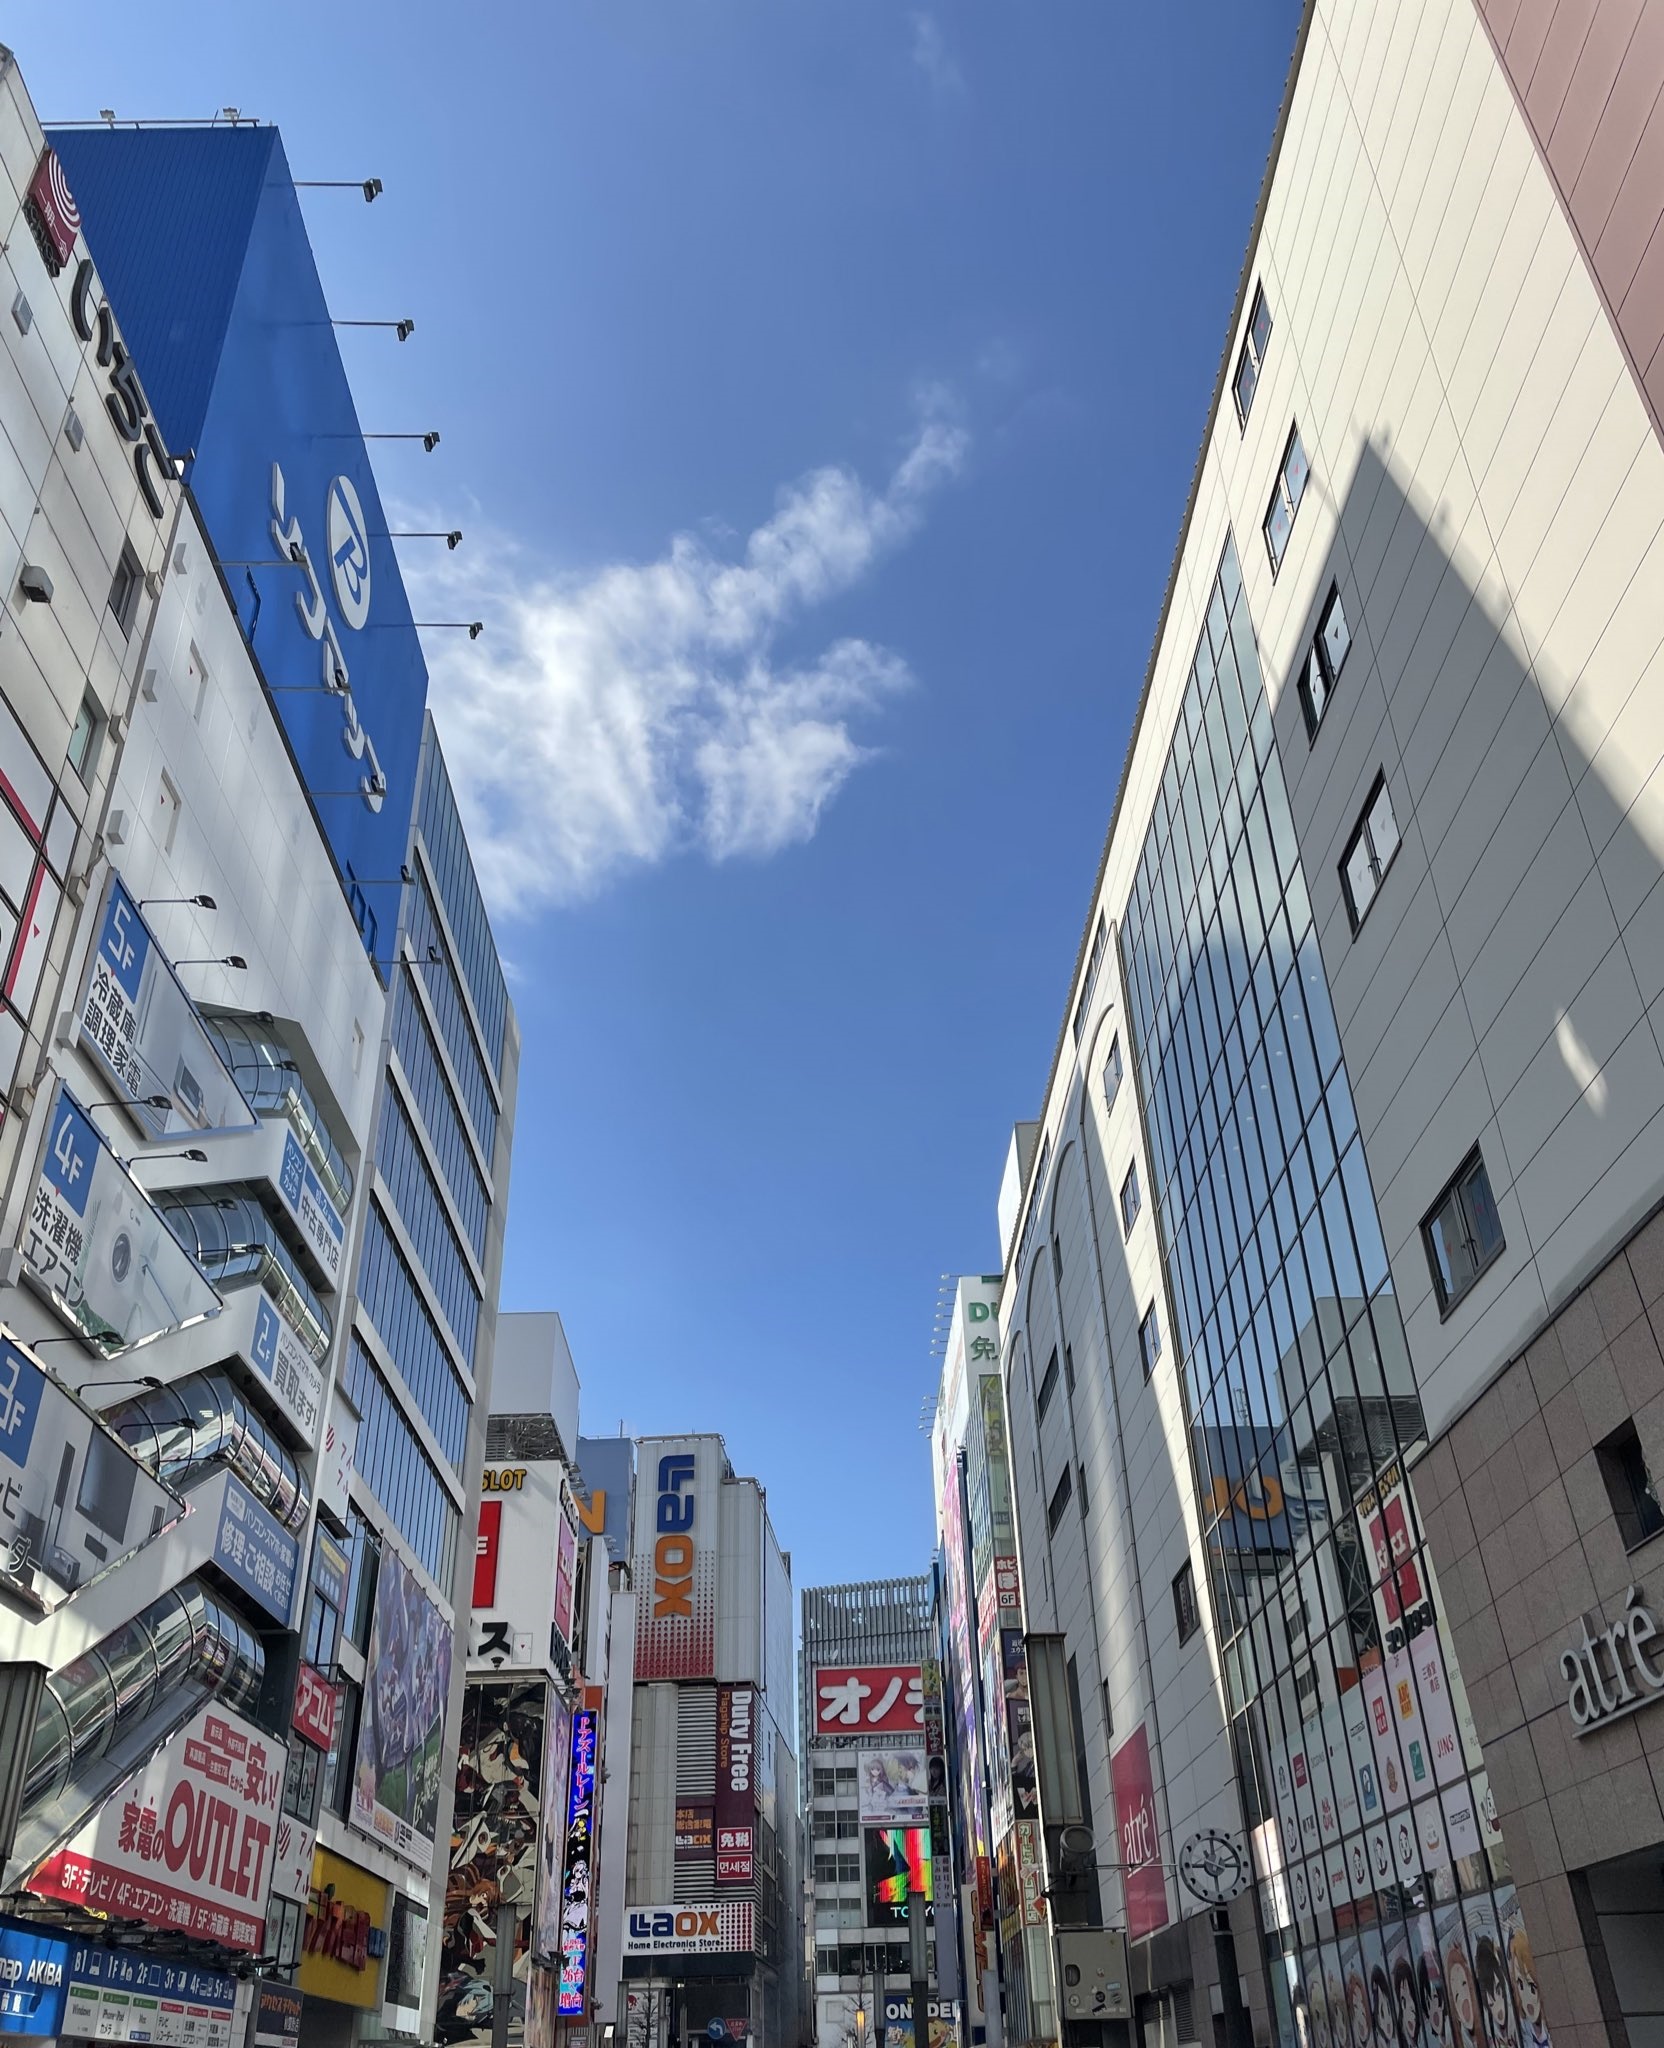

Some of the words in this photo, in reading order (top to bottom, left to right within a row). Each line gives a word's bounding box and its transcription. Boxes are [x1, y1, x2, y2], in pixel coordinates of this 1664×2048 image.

[271, 462, 387, 814] ソフマップ
[108, 899, 135, 971] 5F
[93, 963, 137, 1046] 冷蔵庫
[84, 998, 141, 1098] 調理家電
[54, 1113, 83, 1184] 4F
[32, 1187, 83, 1266] 洗濯機
[301, 1194, 339, 1273] 中古専門店
[23, 1228, 84, 1307] エアコン
[1001, 1594, 1015, 1604] 6F
[1560, 1584, 1664, 1725] atré
[298, 1676, 331, 1737] アコム
[720, 1691, 730, 1735] Flagship
[729, 1690, 752, 1739] Duty
[574, 1716, 593, 1810] Pアズールレーン
[721, 1737, 730, 1768] Store
[730, 1743, 752, 1792] Free
[118, 1801, 166, 1863] 家電の
[164, 1780, 271, 1901] OUTLET
[720, 1832, 750, 1848] 免税
[719, 1861, 751, 1875] 면세점
[26, 1959, 63, 1987] AKIBA
[628, 1940, 651, 1950] Home
[653, 1939, 697, 1949] Electronics
[699, 1938, 720, 1948] Store
[562, 1968, 584, 1983] 26台
